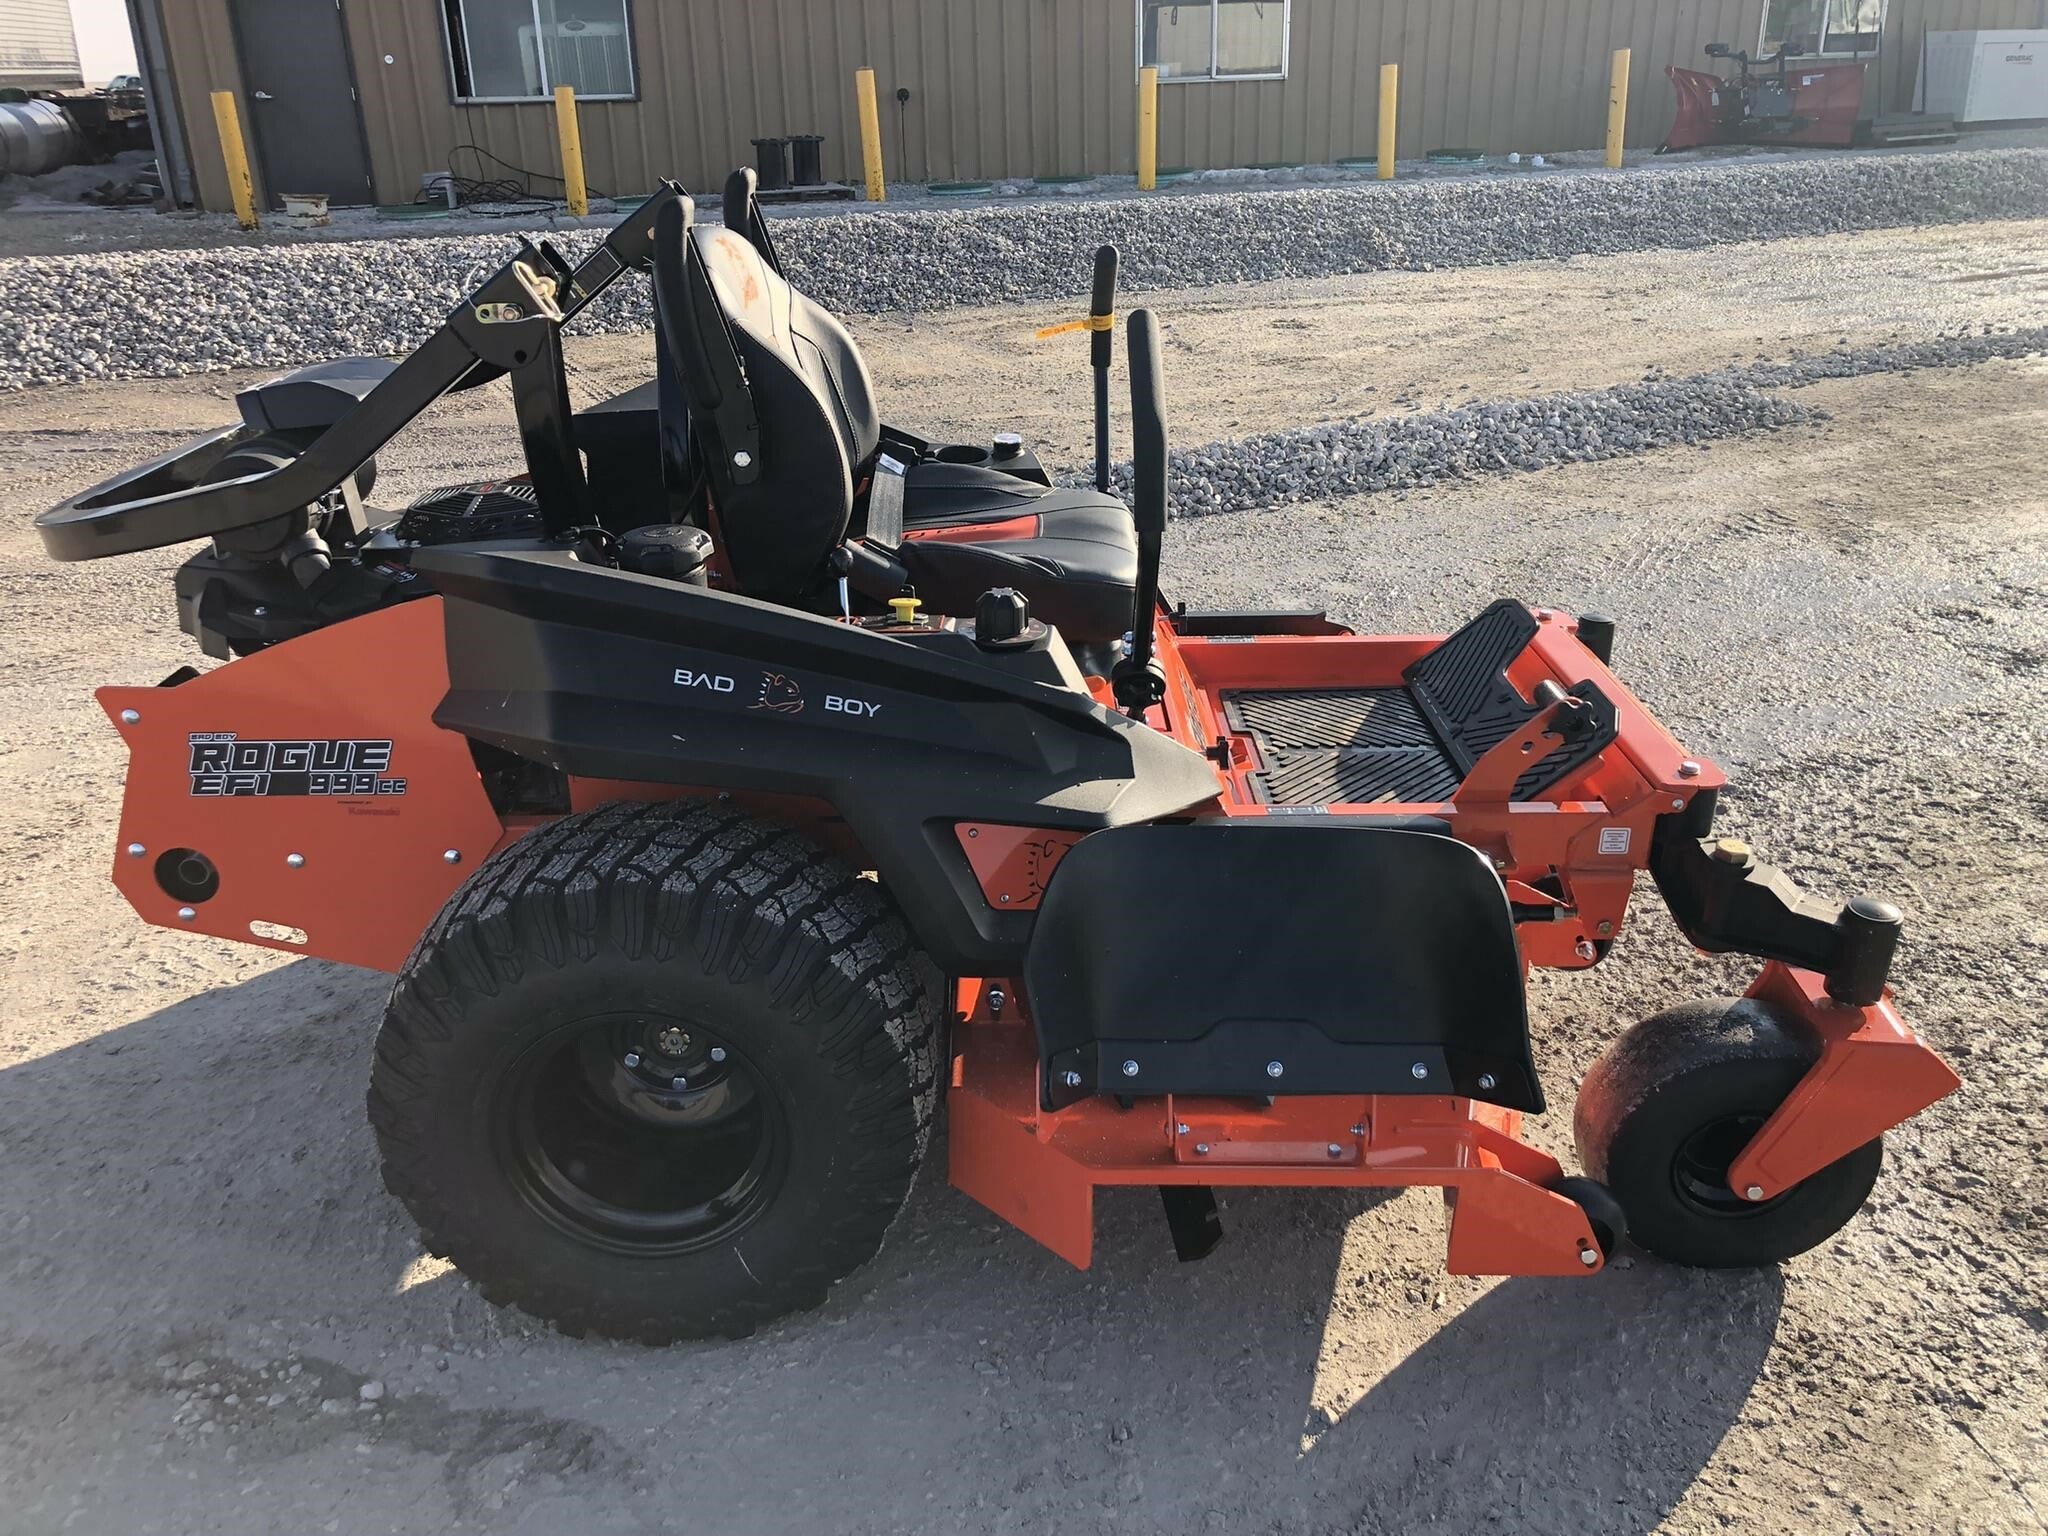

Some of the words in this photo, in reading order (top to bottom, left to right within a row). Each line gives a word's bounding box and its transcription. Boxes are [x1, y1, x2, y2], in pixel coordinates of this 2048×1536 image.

[673, 668, 735, 693] BAD
[824, 694, 882, 717] BOY
[189, 732, 213, 740] BAD
[213, 732, 237, 740] BOY
[189, 740, 392, 772] ROGUE
[190, 772, 271, 795] EFI
